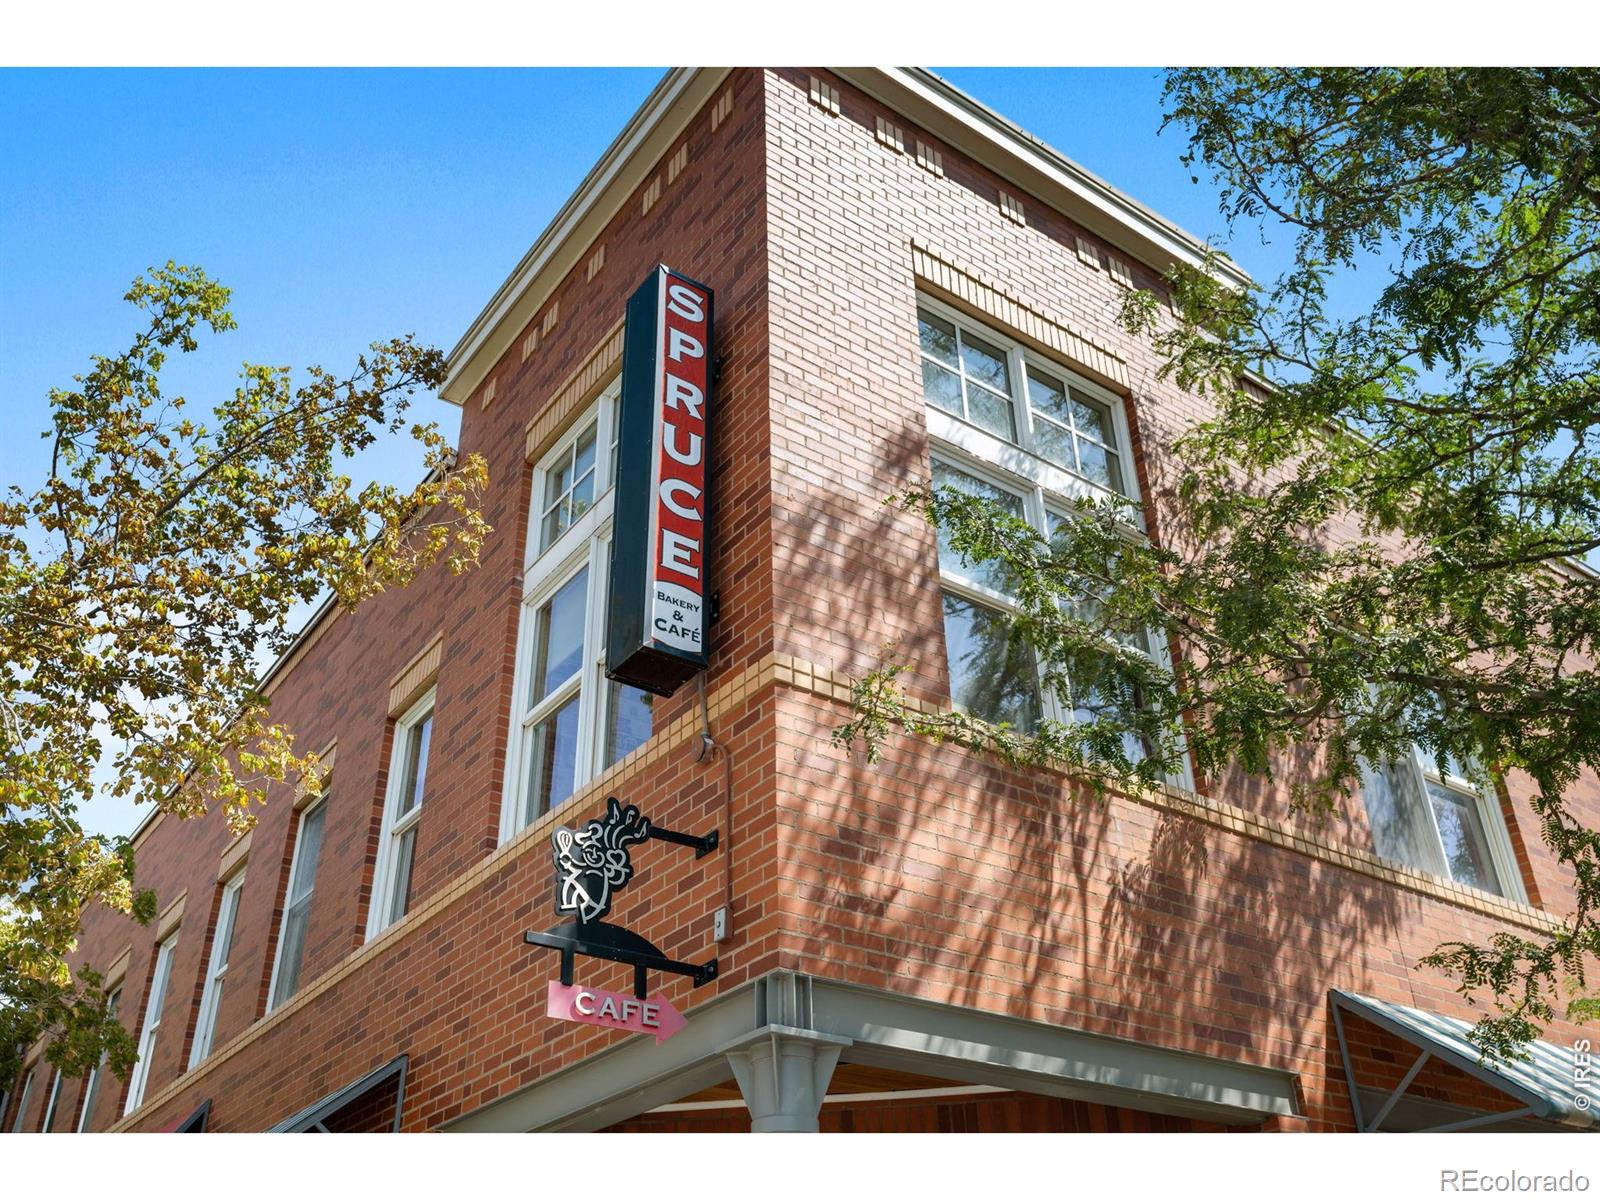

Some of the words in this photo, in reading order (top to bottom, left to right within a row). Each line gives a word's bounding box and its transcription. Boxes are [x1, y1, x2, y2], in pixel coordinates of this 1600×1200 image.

[659, 284, 704, 580] SPRUCE
[657, 591, 700, 612] BAKERY
[672, 610, 684, 622] &
[654, 617, 701, 643] CAFÉ
[575, 992, 661, 1028] CAFE
